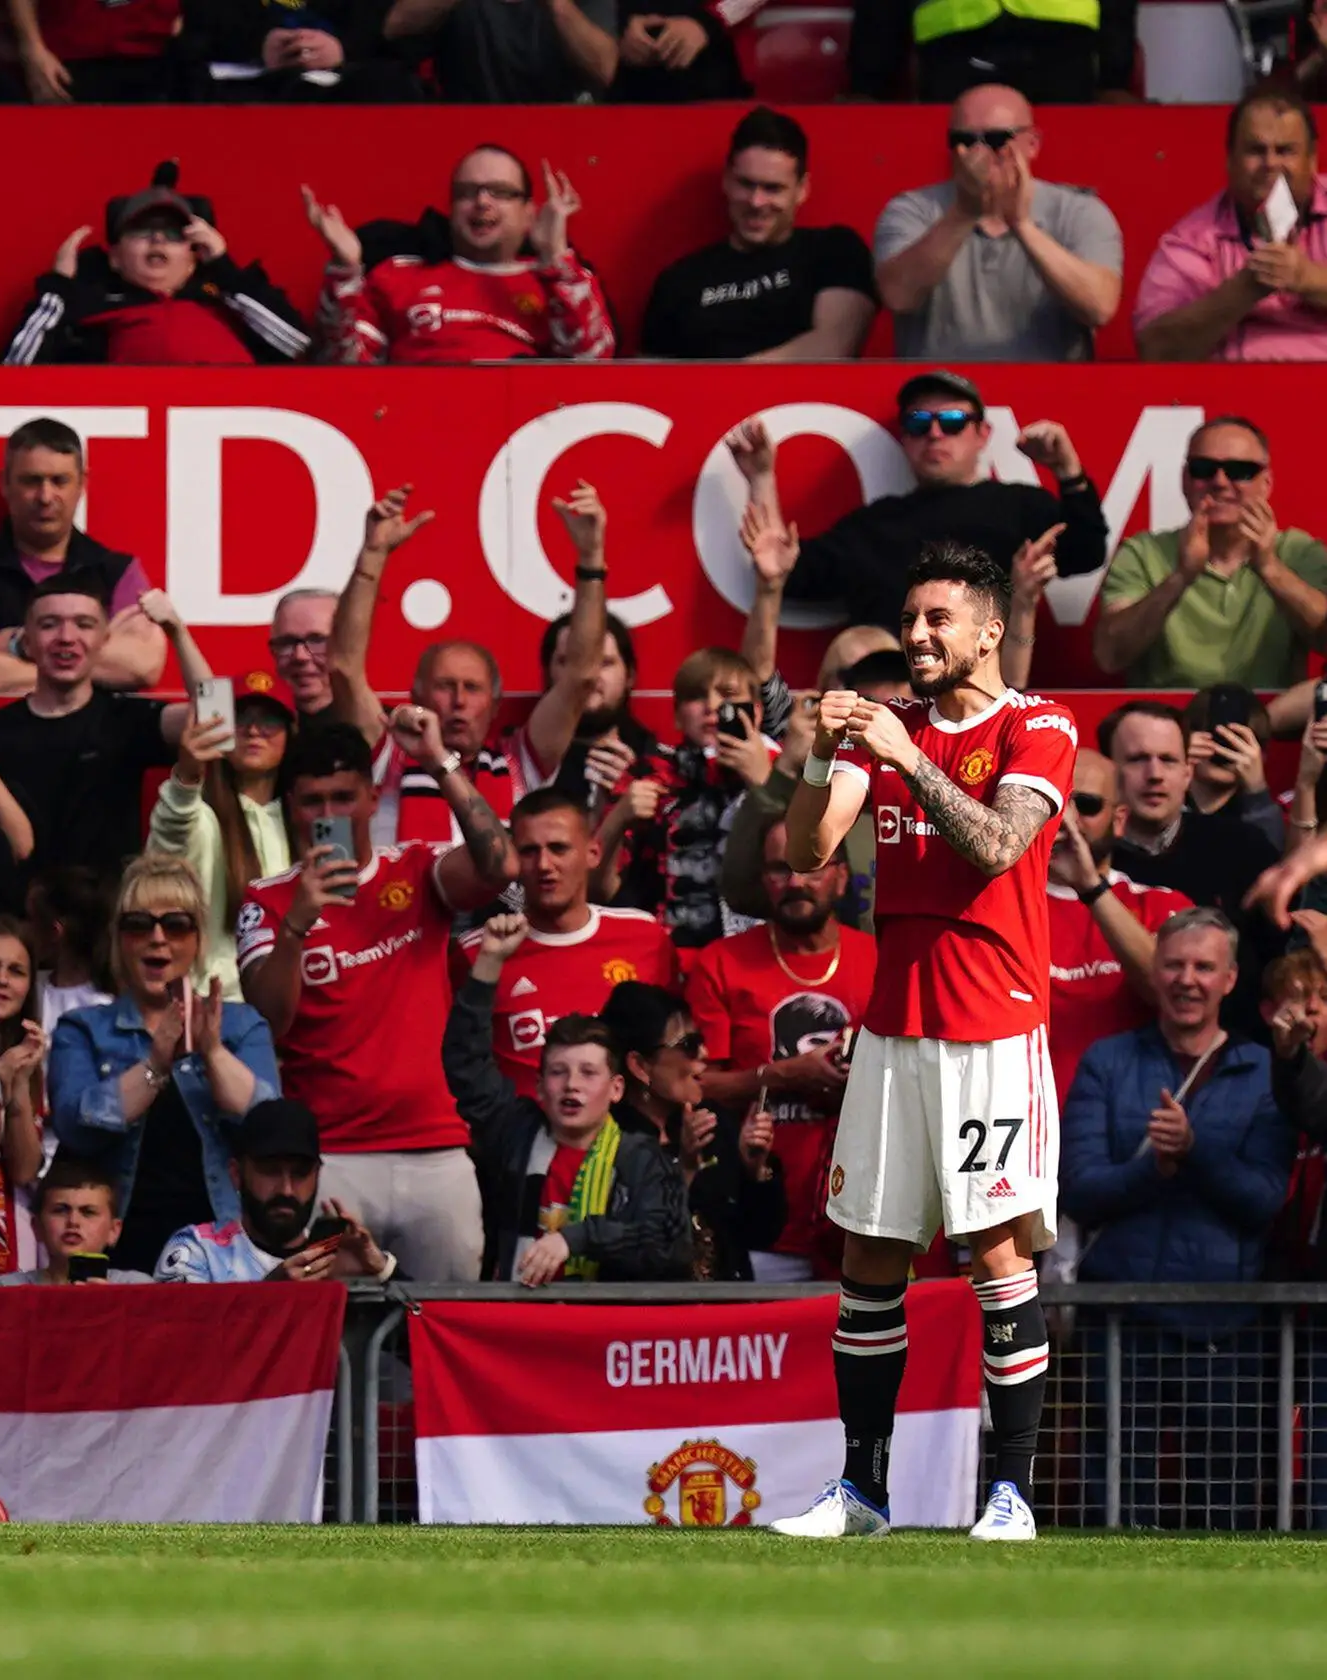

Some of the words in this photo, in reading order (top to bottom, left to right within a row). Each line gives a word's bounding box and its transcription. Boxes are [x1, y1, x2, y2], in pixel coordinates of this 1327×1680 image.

[1025, 714, 1078, 750] KOHL
[958, 1118, 1025, 1172] 27
[986, 1189, 1017, 1198] adidas
[605, 1332, 789, 1388] GERMANY
